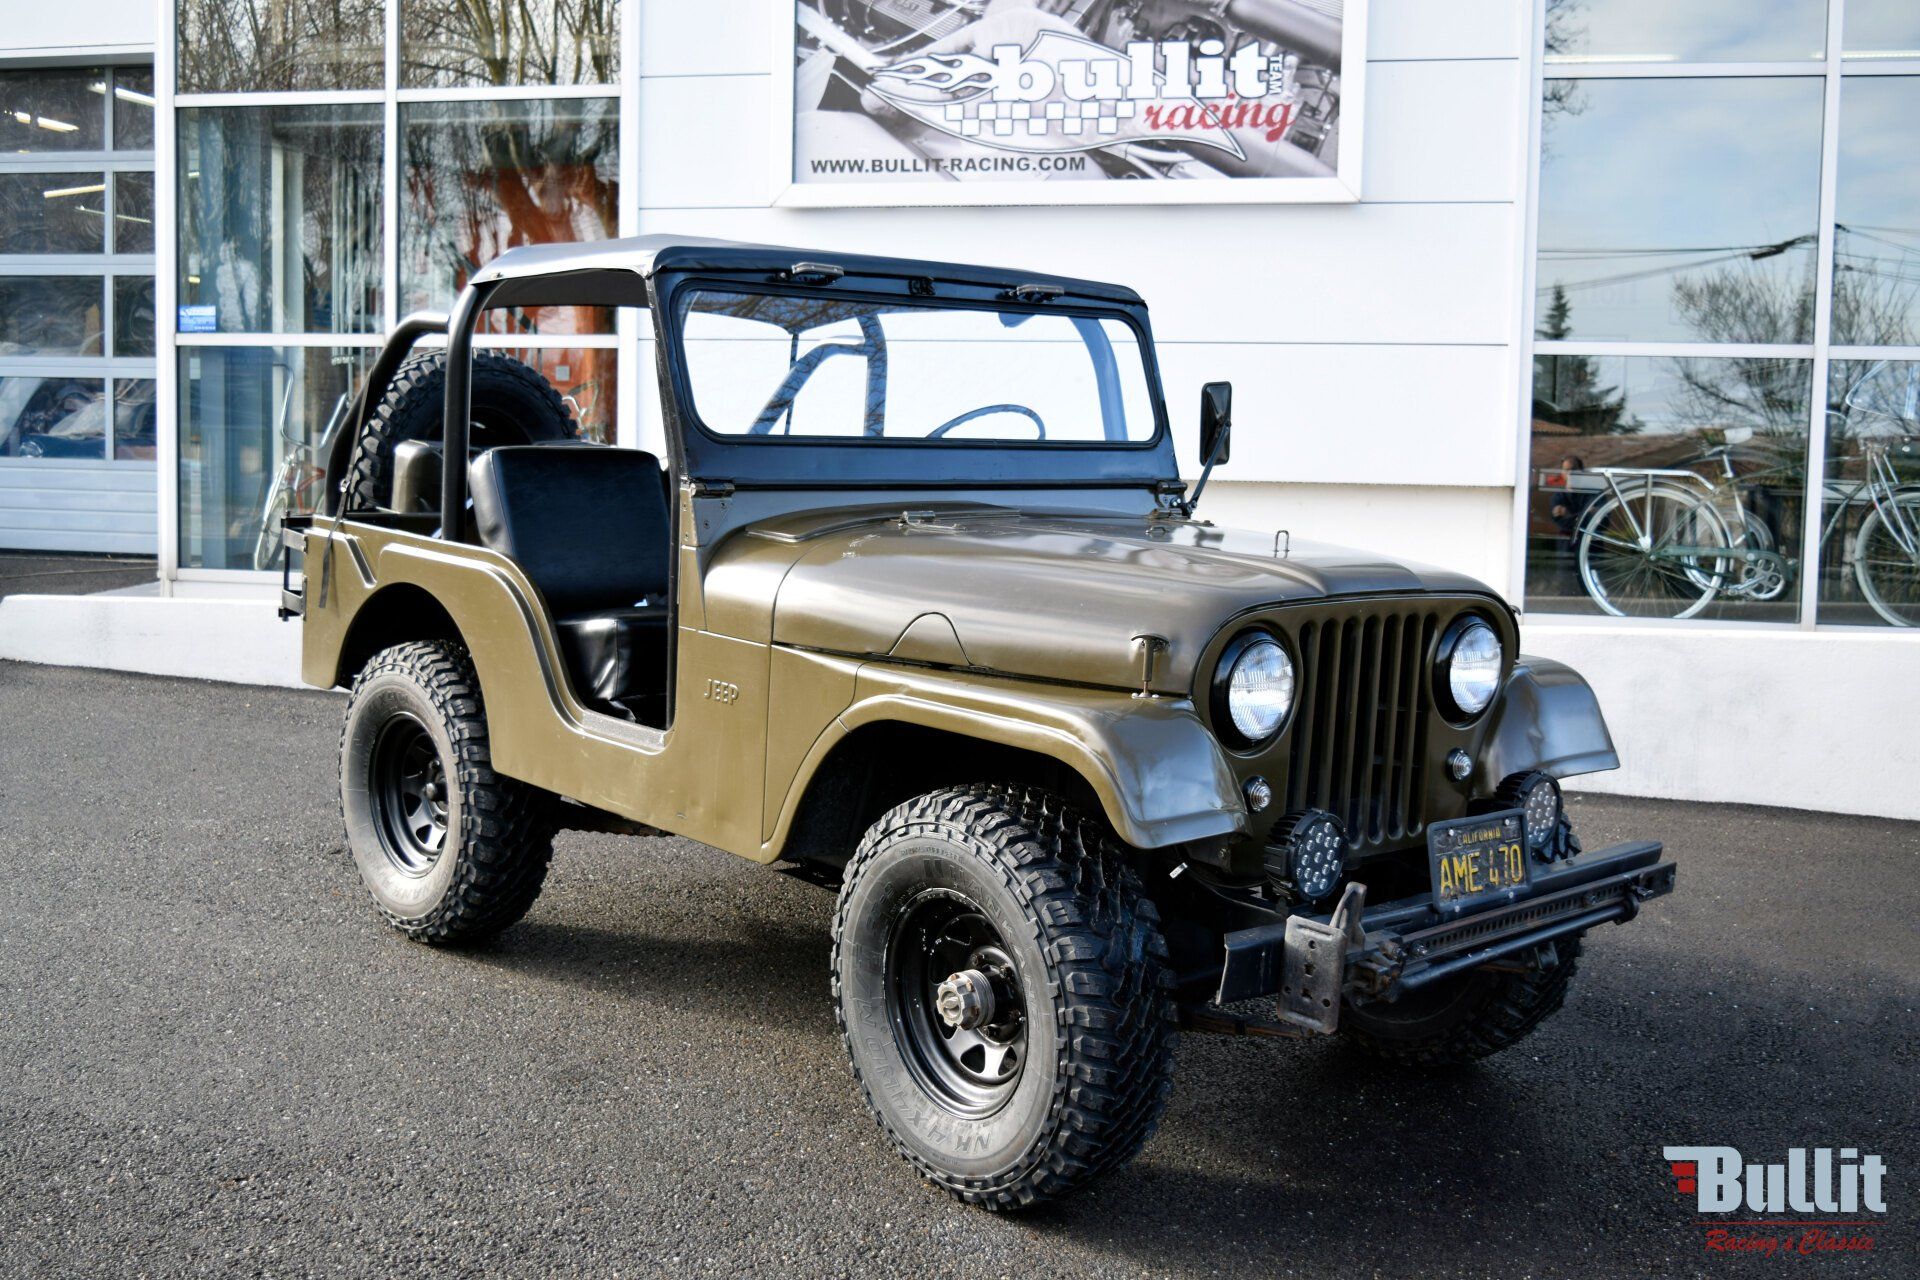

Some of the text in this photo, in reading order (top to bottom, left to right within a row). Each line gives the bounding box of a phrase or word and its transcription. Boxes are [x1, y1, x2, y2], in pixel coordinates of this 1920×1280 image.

[992, 39, 1270, 102] bullit
[1269, 53, 1283, 96] TEAM
[1144, 93, 1296, 143] racing
[811, 156, 1086, 174] WWW.BULLIT-RACING.COM
[703, 678, 740, 706] JEEP
[1457, 826, 1502, 846] CALIFORNIA
[1440, 851, 1484, 898] AME
